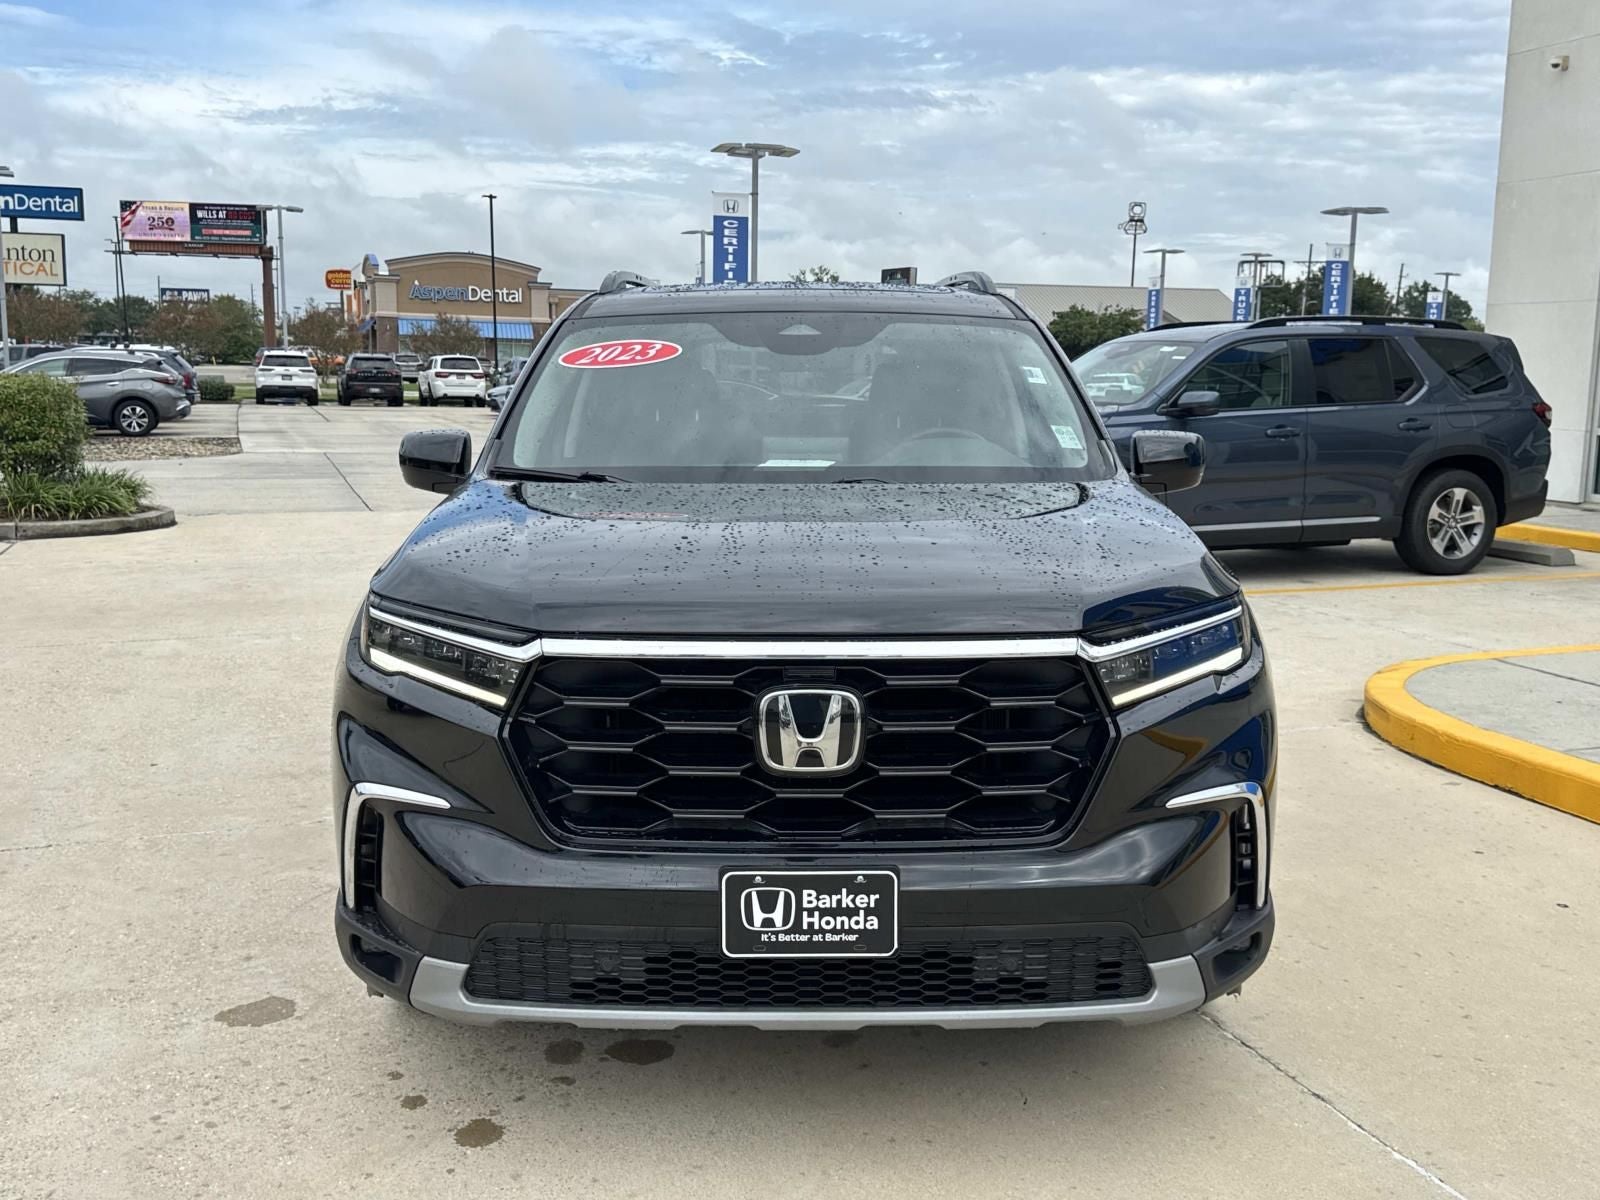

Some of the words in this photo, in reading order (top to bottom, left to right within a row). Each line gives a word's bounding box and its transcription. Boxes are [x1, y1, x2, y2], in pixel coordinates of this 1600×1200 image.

[147, 216, 175, 227] 250
[196, 209, 217, 219] WILLS
[218, 210, 227, 219] AT
[574, 344, 663, 364] 2023
[802, 888, 880, 908] Barker
[802, 910, 879, 930] Honda
[761, 933, 776, 942] It's
[778, 933, 811, 942] Better
[812, 934, 824, 942] at
[825, 933, 859, 942] Barker
